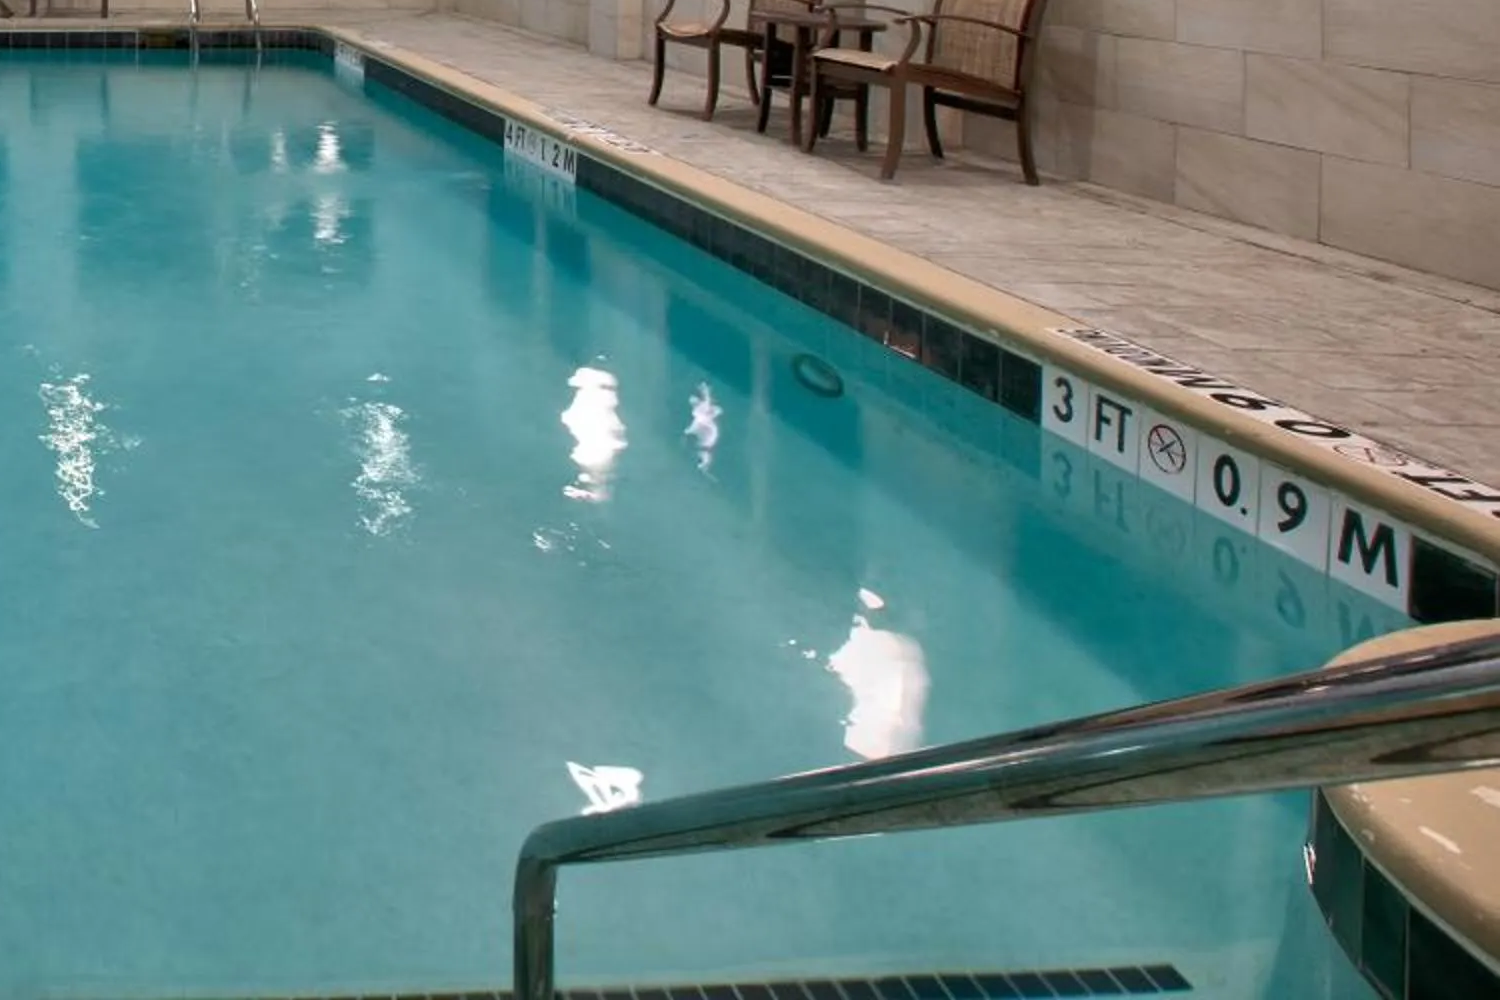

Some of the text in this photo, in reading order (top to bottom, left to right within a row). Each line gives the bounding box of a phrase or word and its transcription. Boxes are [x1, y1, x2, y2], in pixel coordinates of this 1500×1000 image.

[505, 123, 513, 145] 4
[563, 147, 575, 175] M
[1052, 377, 1074, 423] 3
[1095, 394, 1132, 452] FT
[1338, 507, 1399, 588] M
